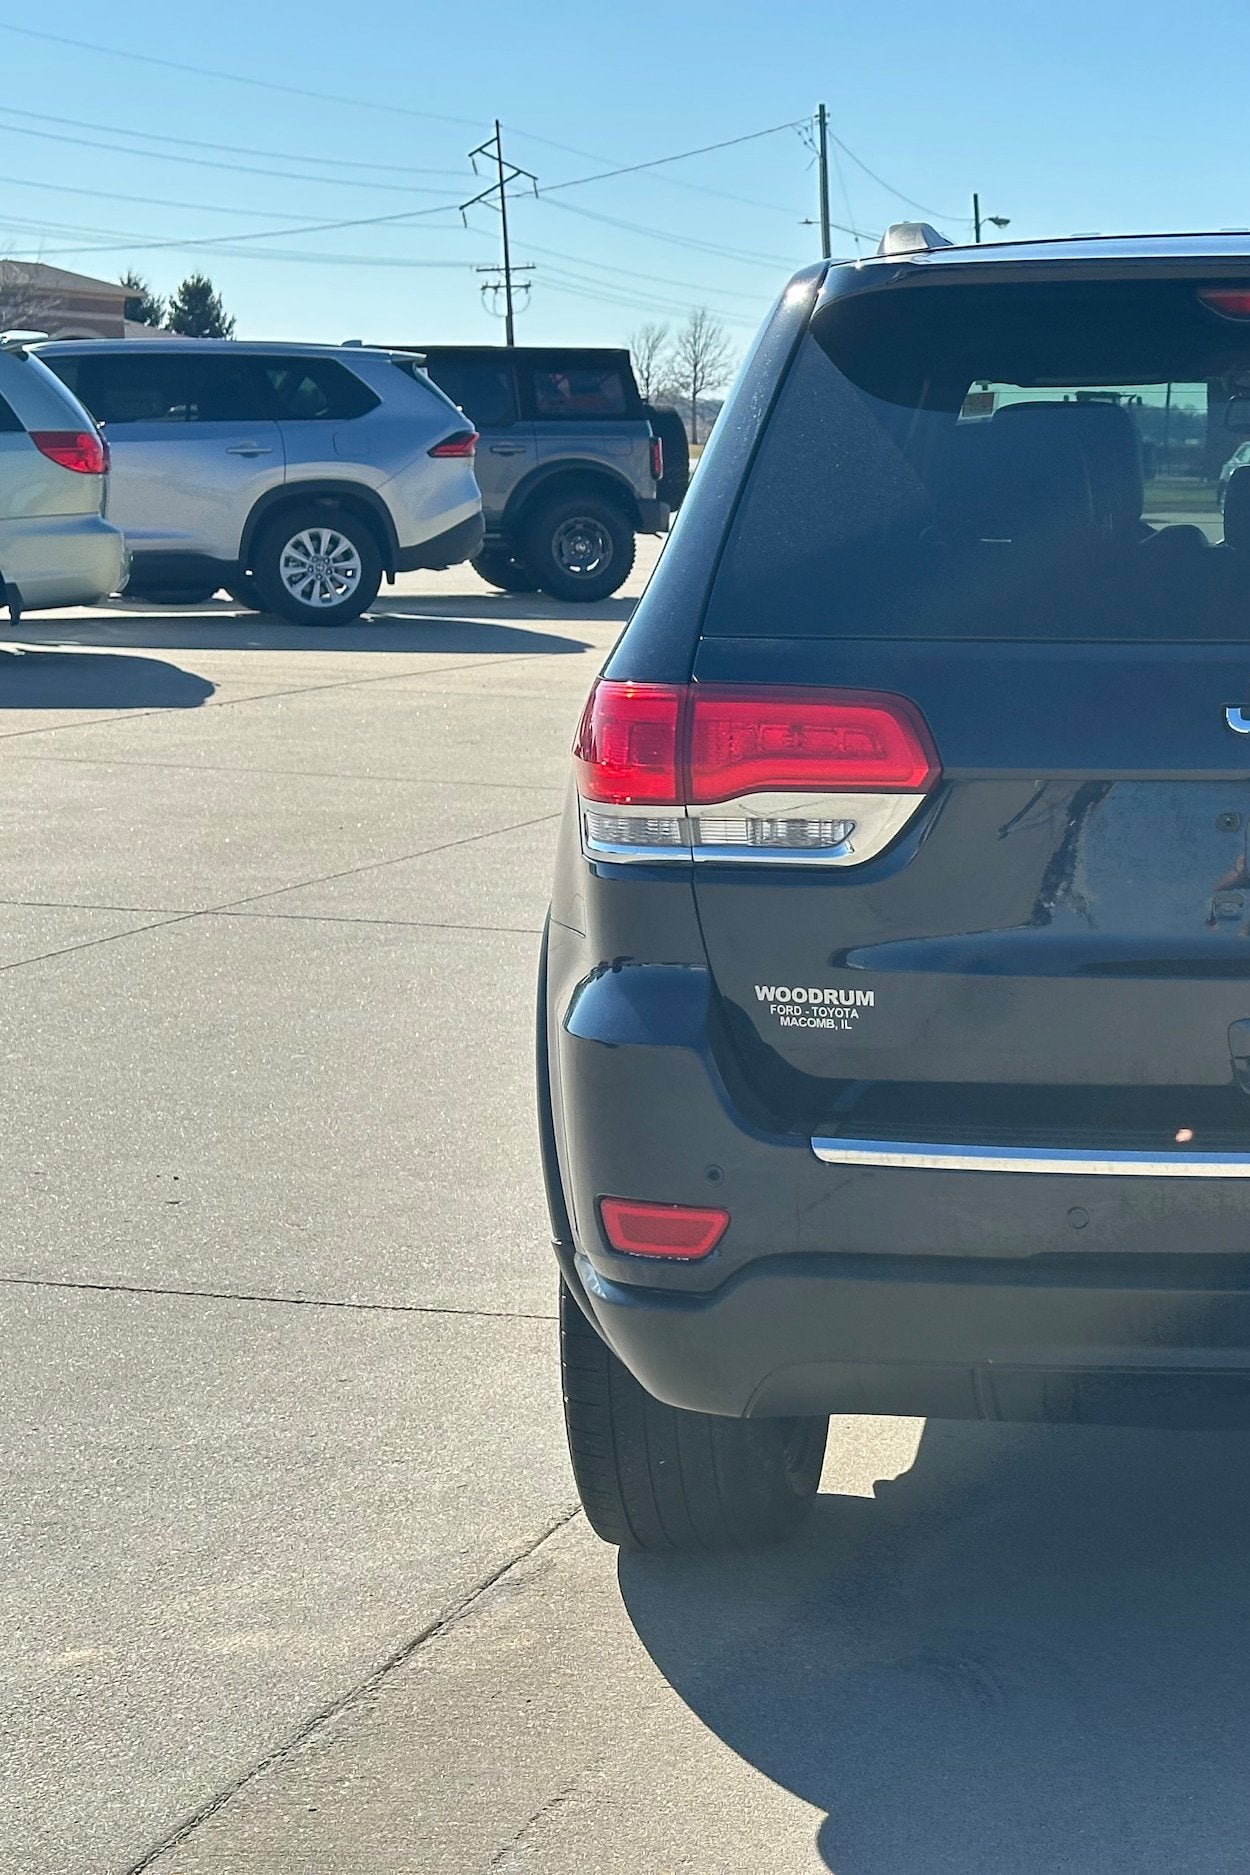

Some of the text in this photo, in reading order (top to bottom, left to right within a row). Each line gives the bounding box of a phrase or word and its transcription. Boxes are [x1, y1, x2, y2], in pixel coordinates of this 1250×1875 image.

[754, 985, 875, 1007] WOODRUM
[769, 1004, 802, 1015] FORD
[811, 1006, 859, 1019] TOYOTA
[780, 1016, 853, 1030] MACOMB, IL
